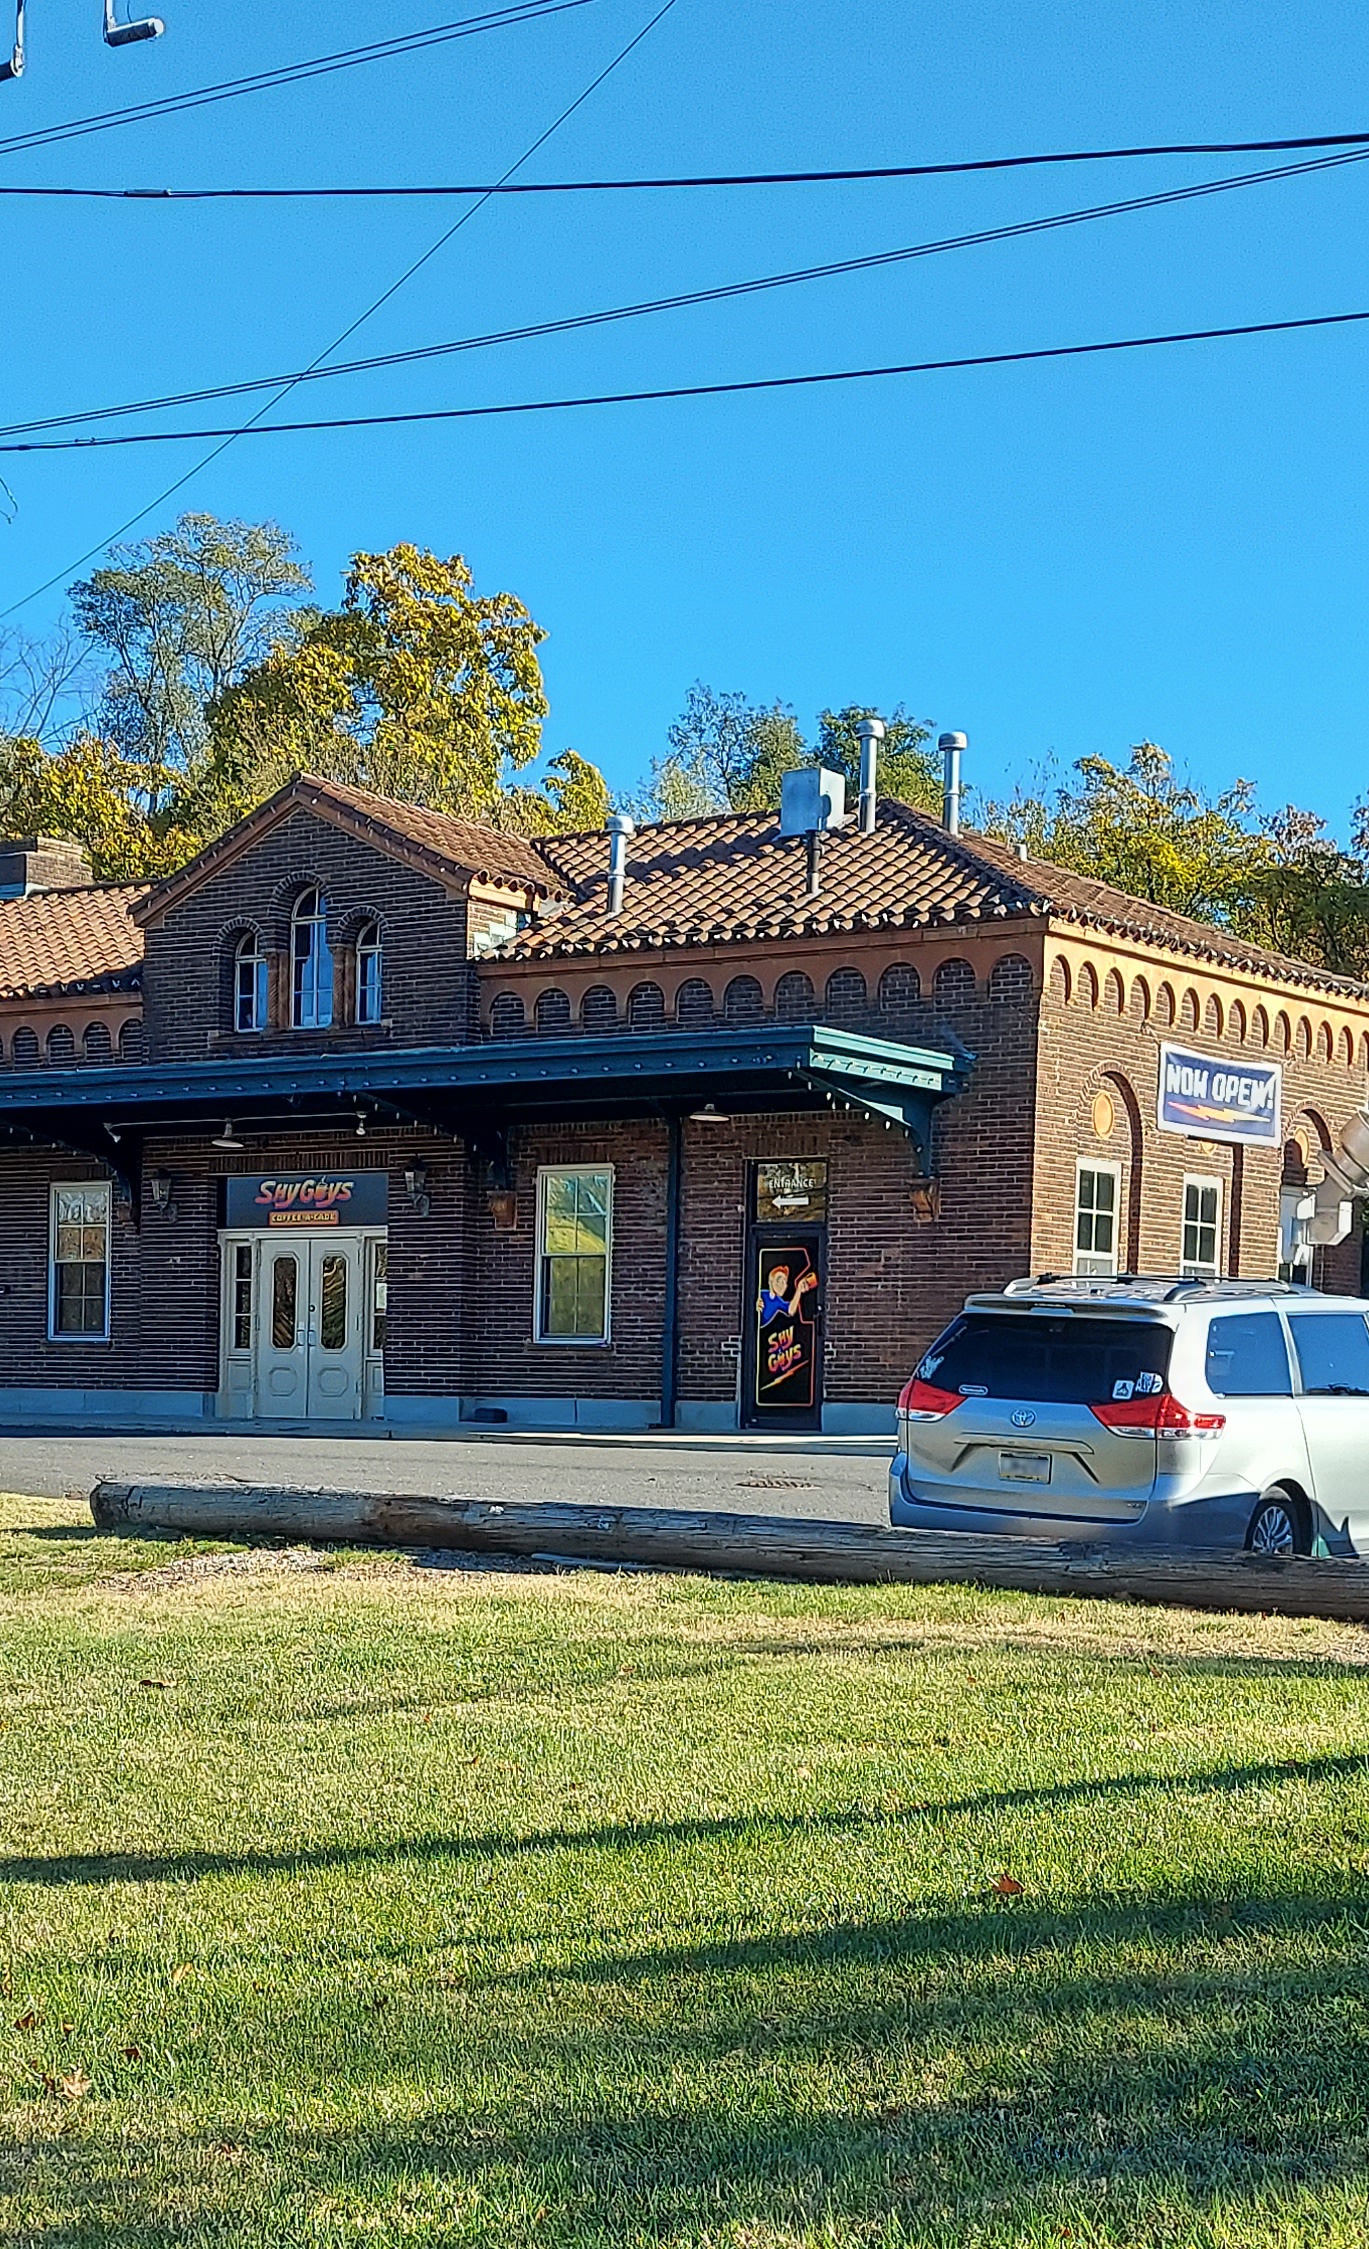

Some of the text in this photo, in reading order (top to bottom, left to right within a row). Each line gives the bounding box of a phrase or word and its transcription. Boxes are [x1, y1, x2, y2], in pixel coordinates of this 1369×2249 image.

[1166, 1063, 1275, 1110] NOW OPEN!
[769, 1177, 814, 1189] ENTRANCE
[768, 1325, 794, 1353] SHY
[768, 1344, 801, 1372] GUYS
